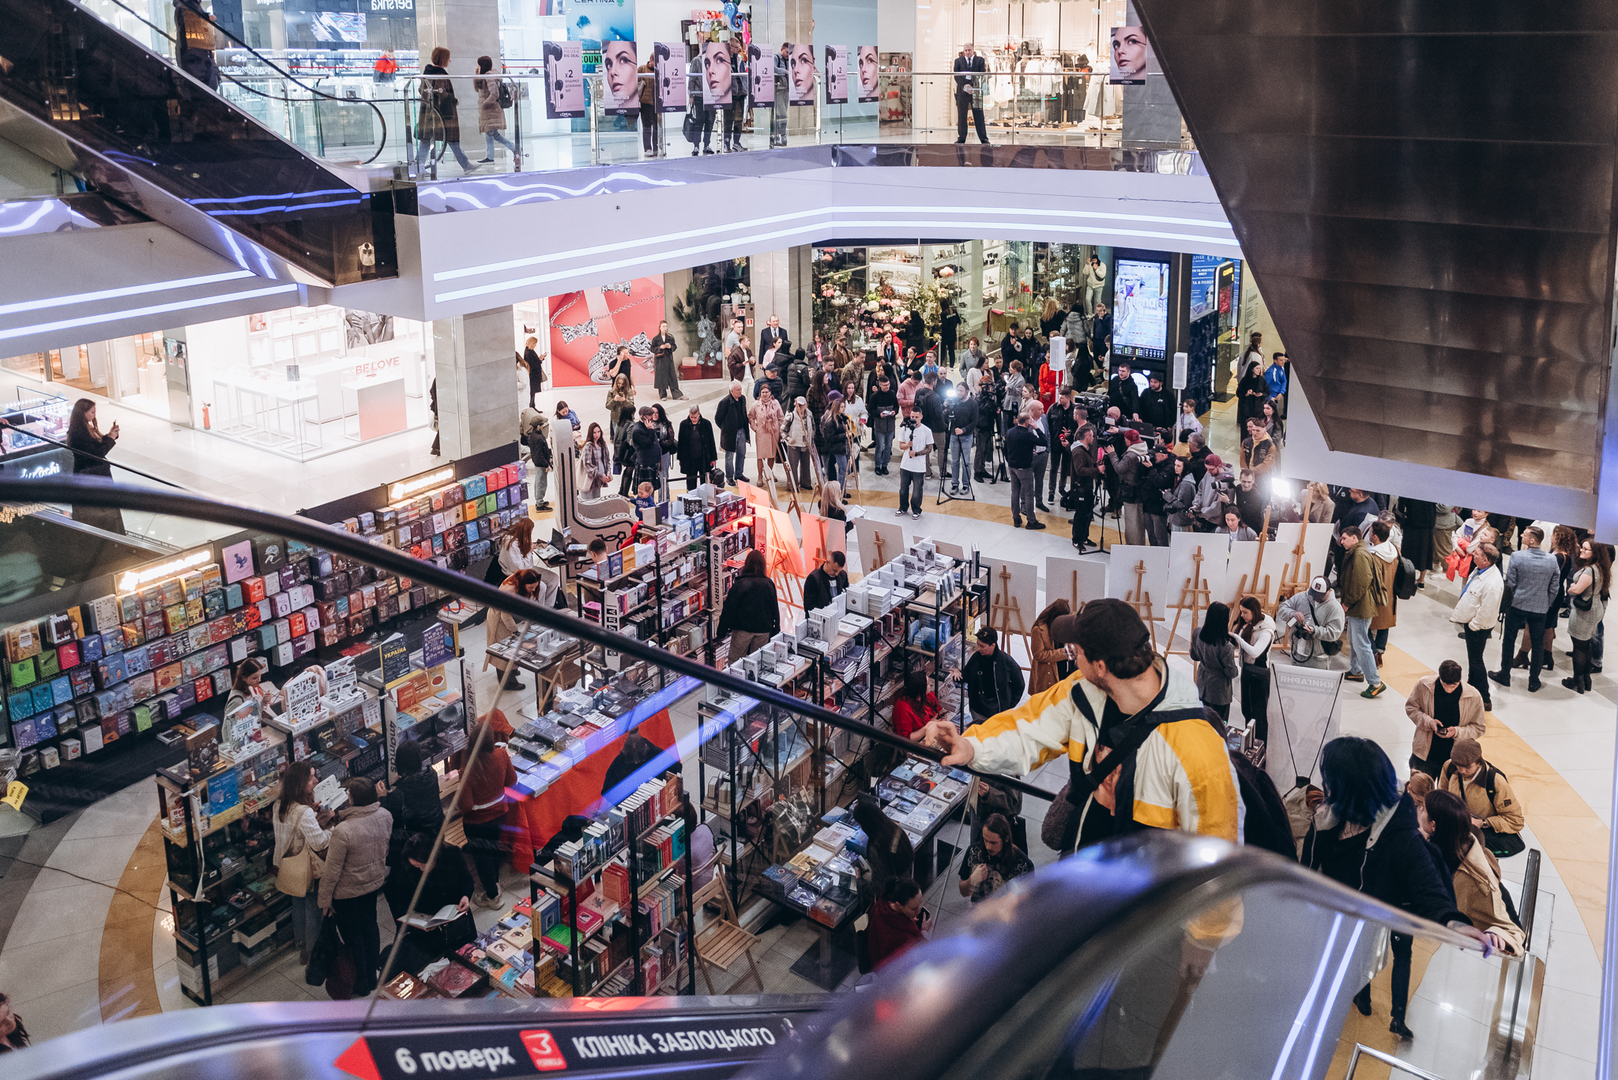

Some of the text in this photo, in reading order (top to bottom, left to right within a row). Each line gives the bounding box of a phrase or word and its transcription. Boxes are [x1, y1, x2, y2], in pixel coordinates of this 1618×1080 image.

[395, 1026, 777, 1073] 6 поверх КЛІНІКА ЗАБЛОЦЬКОГО
